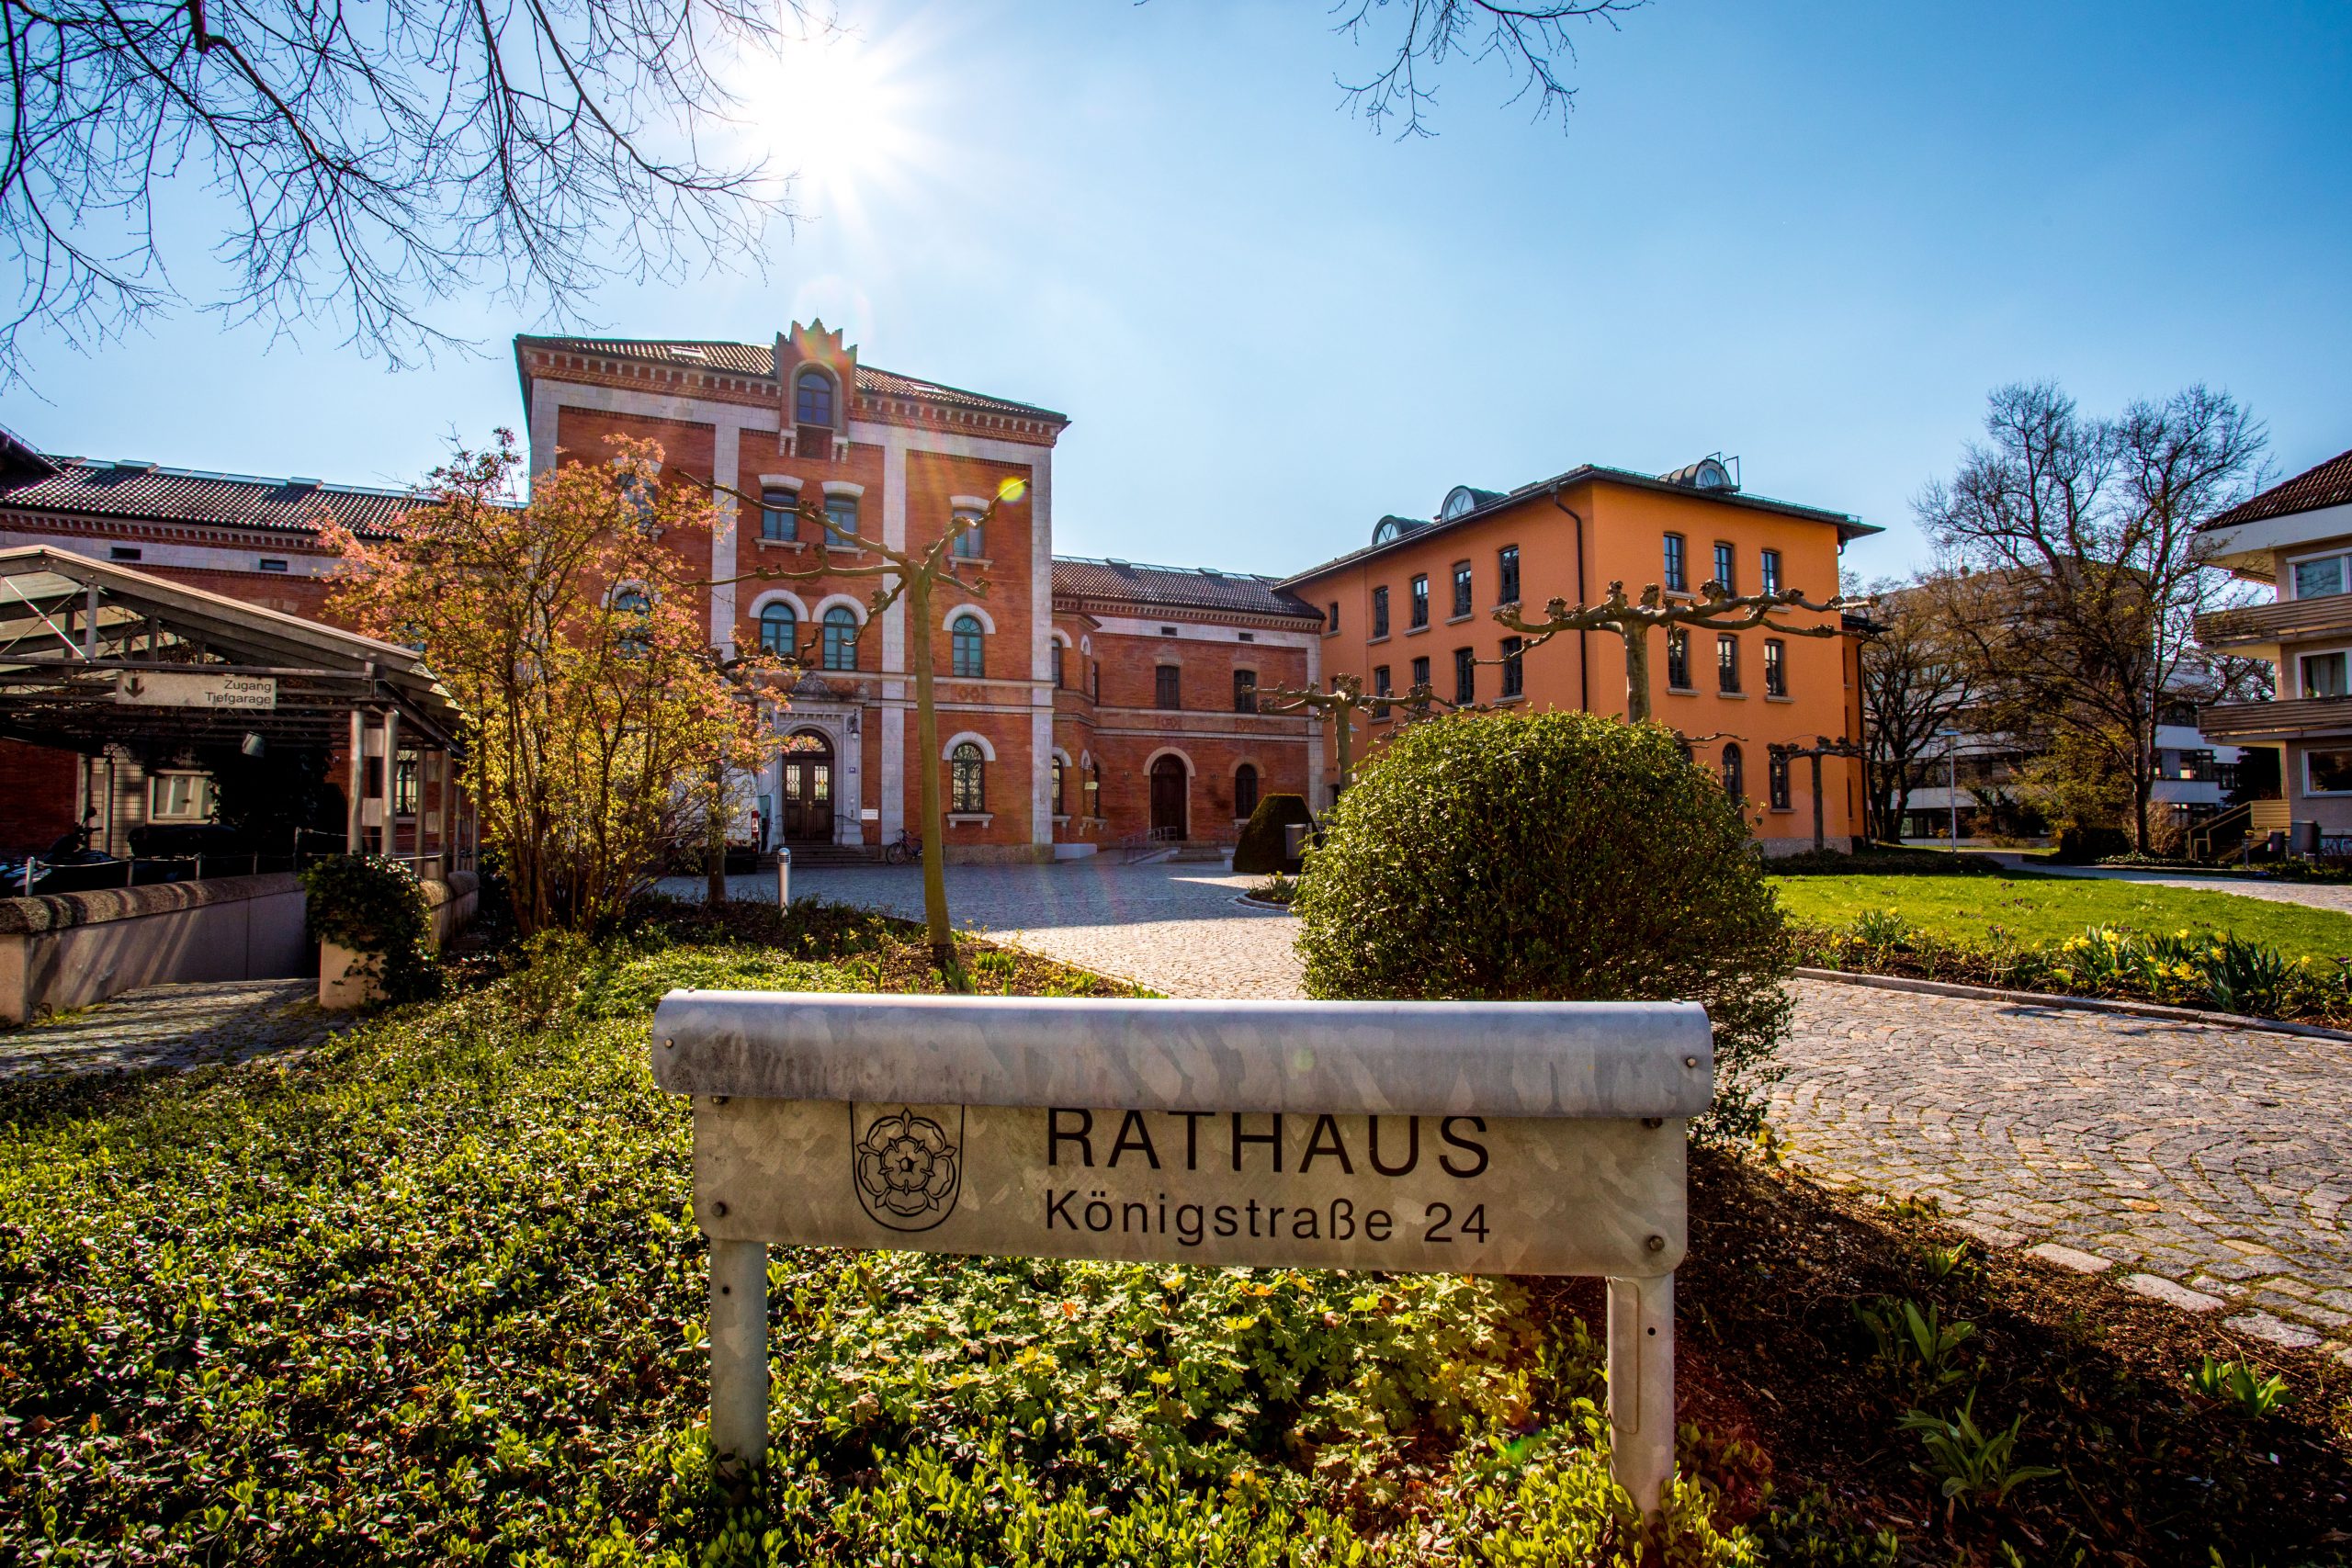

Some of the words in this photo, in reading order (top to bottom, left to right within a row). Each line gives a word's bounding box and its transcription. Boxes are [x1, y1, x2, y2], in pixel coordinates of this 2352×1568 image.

[205, 692, 272, 705] Tiefgarage
[223, 679, 272, 693] Zugang
[1047, 1107, 1489, 1178] RATHAUS
[1046, 1189, 1393, 1247] Königstraße
[1424, 1201, 1490, 1243] 24
